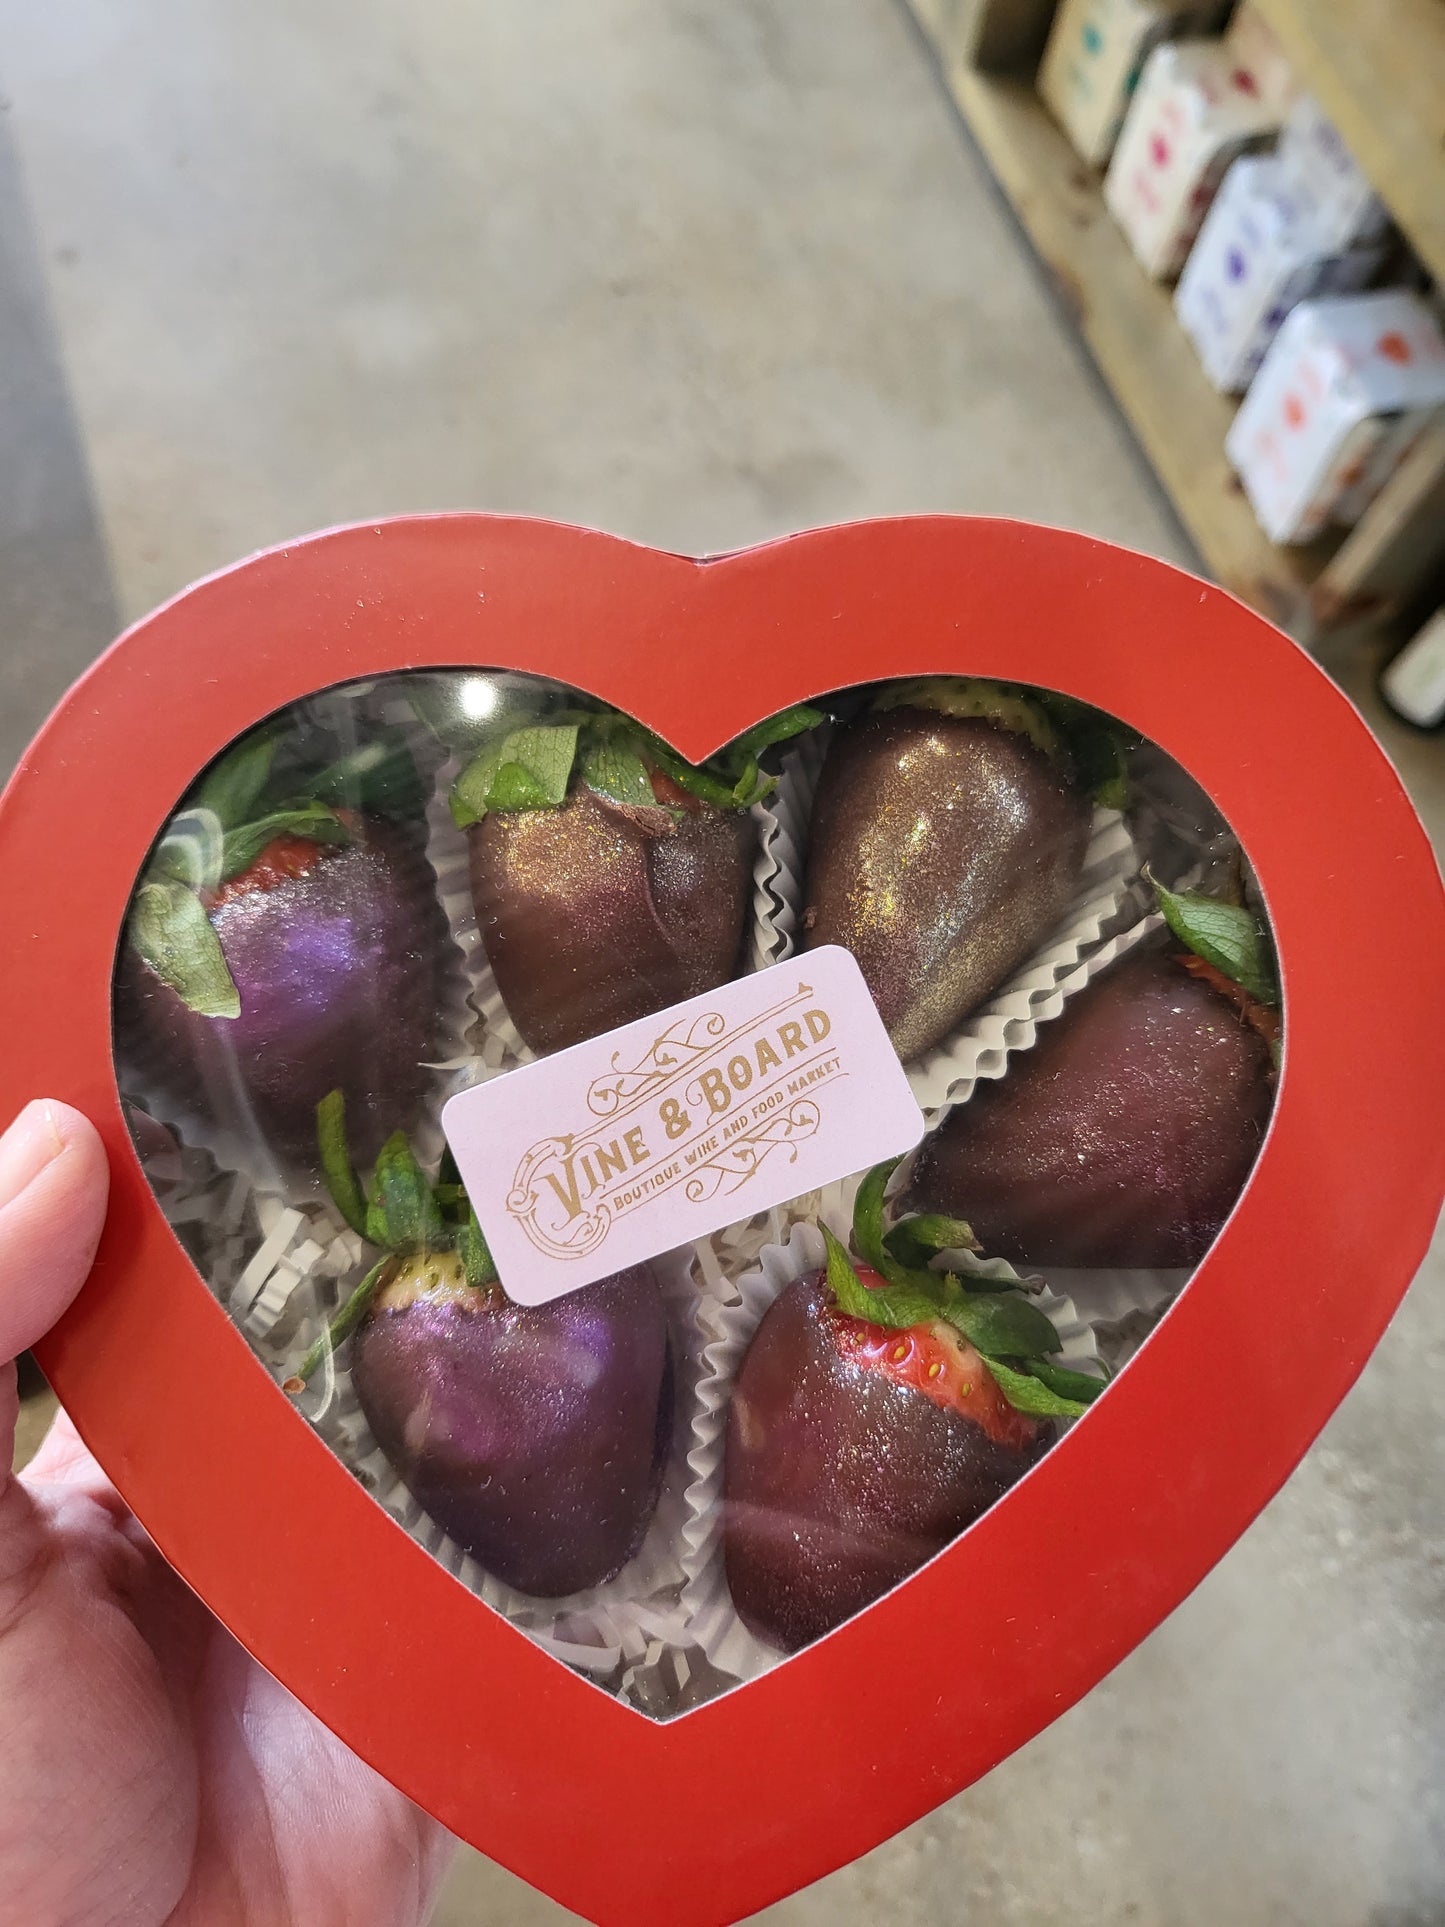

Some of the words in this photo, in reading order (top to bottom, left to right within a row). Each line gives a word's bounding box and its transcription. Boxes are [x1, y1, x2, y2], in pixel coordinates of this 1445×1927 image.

[534, 1125, 651, 1230] VINE
[659, 1098, 692, 1140] &
[687, 1009, 831, 1124] BOARD
[613, 1162, 682, 1211] BOUTIQUE
[684, 1135, 719, 1166] WINE
[722, 1115, 749, 1140] AND
[751, 1091, 784, 1119] FOOD
[786, 1056, 841, 1096] MARKET
